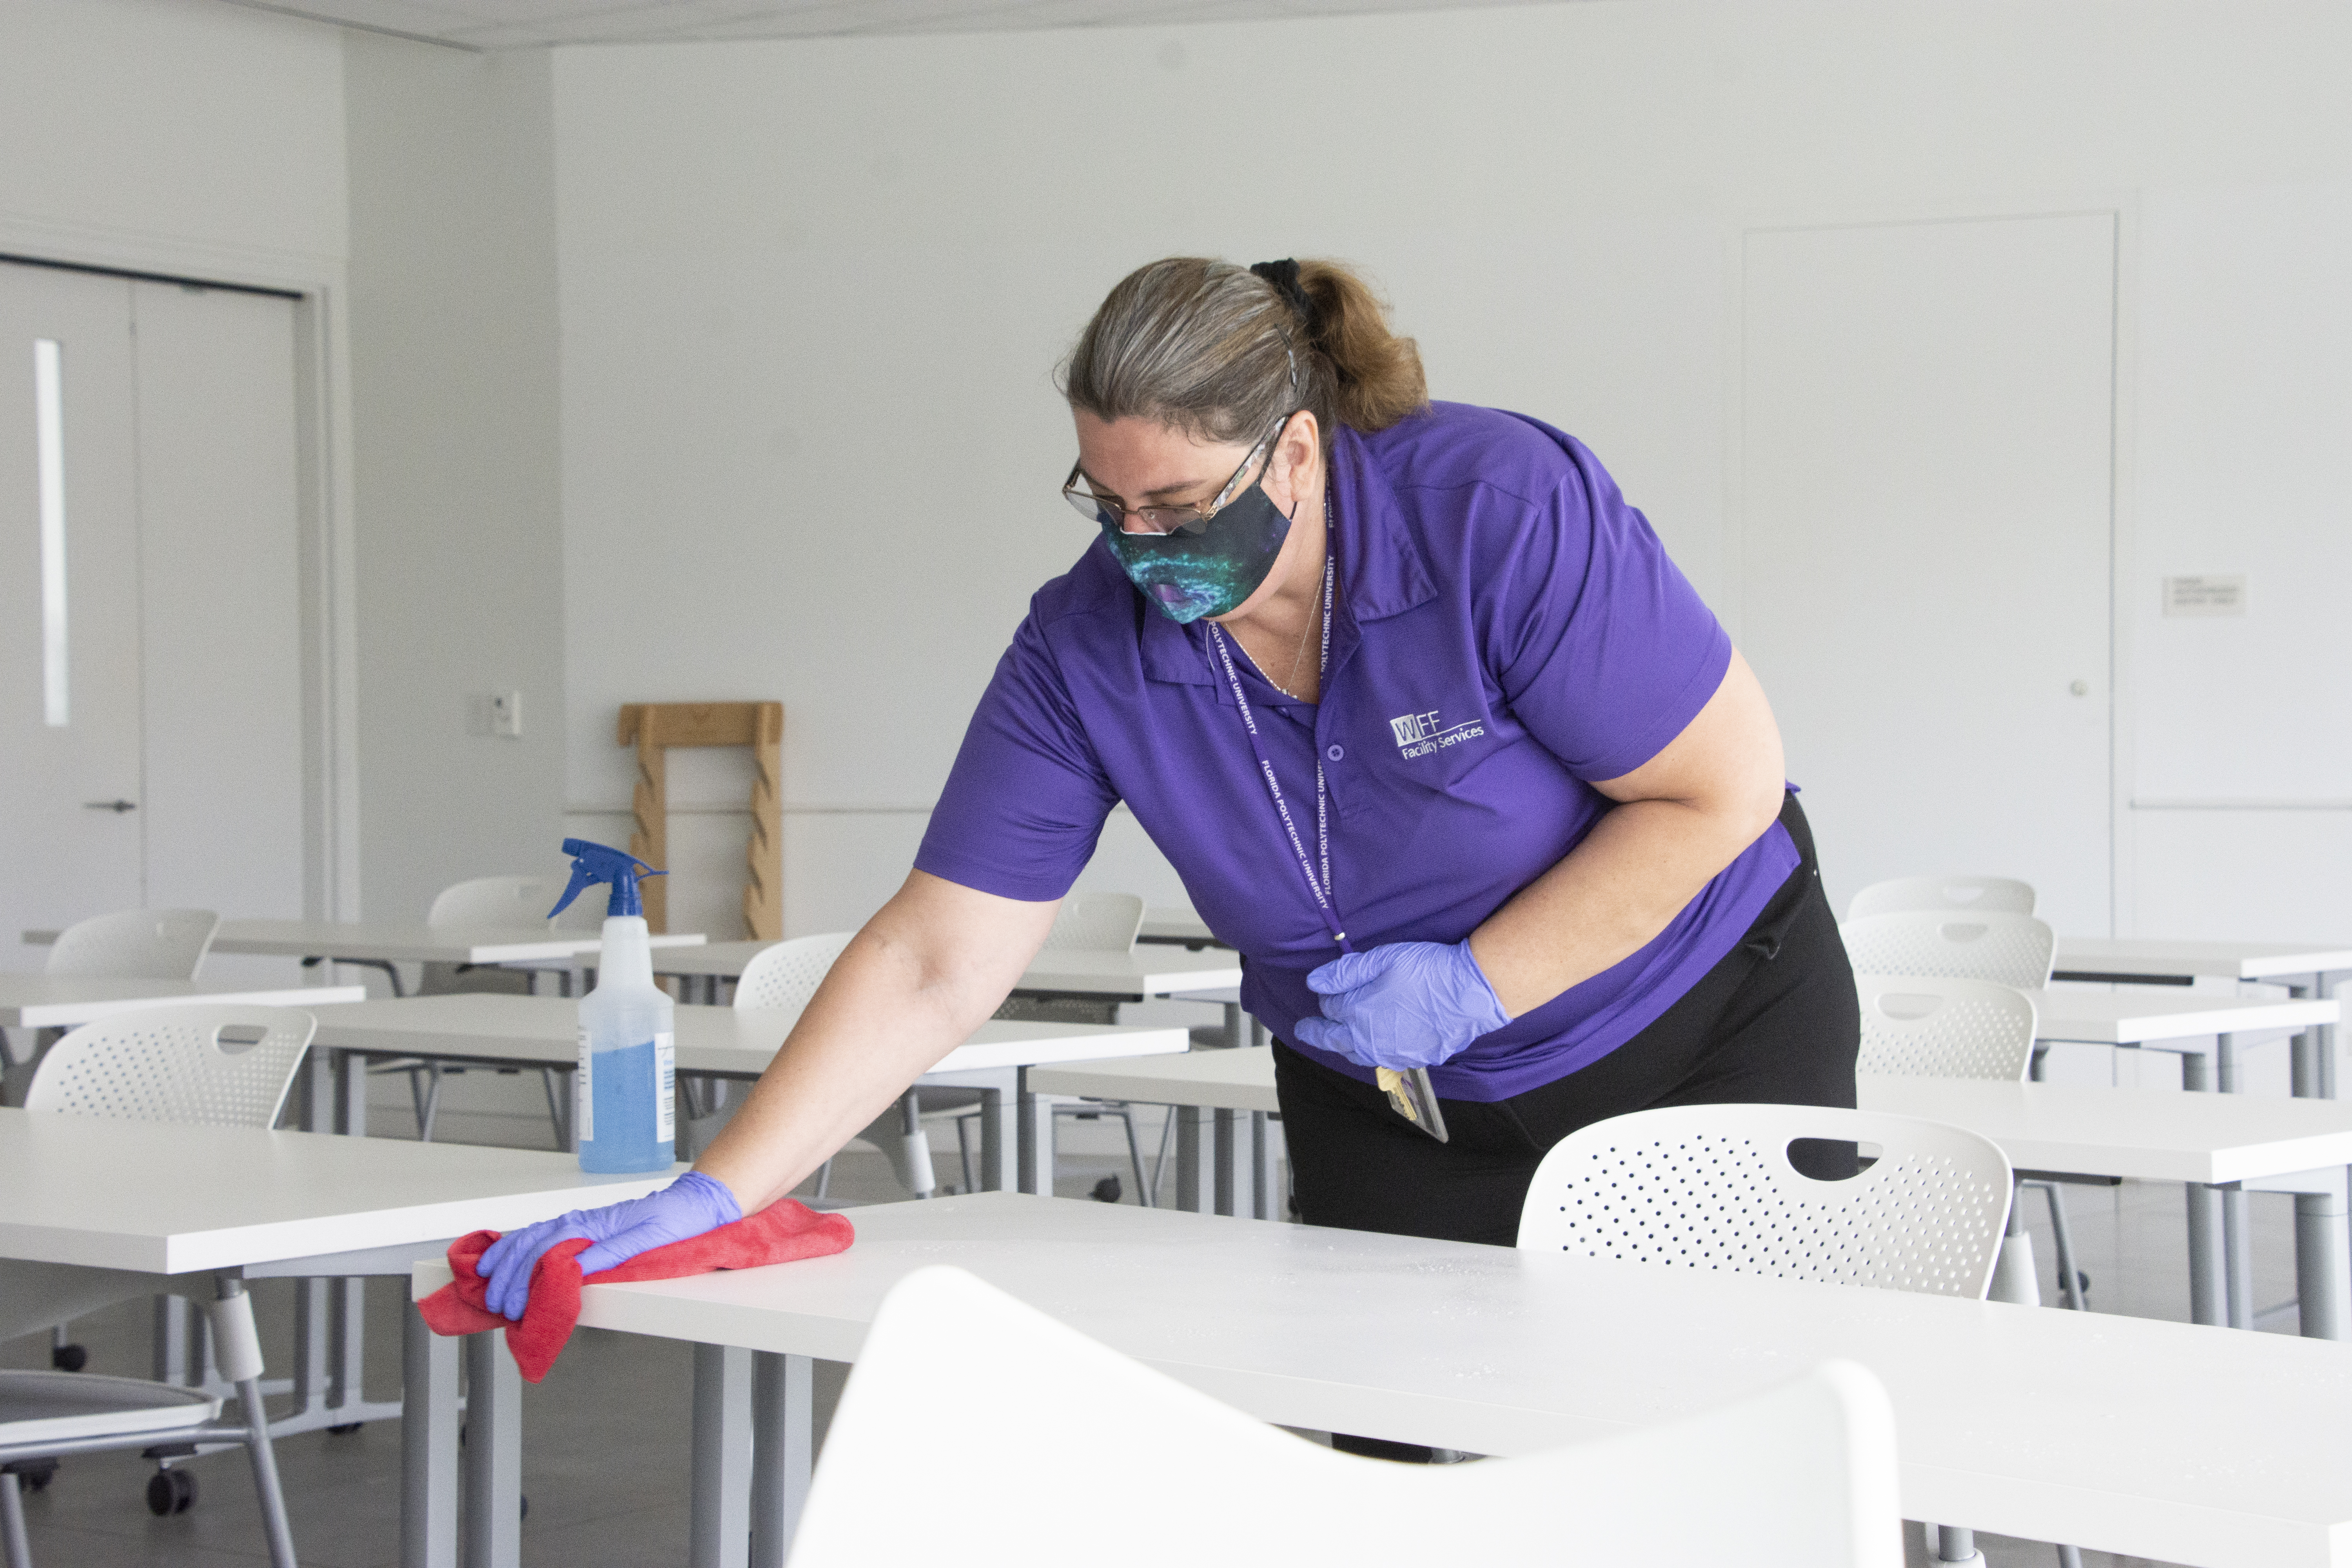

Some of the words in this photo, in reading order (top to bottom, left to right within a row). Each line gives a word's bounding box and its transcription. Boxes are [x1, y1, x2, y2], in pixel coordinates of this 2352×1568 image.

[1325, 555, 1335, 609] UNIVERSITY
[1209, 621, 1237, 681] POLYTECHNIC
[1233, 682, 1257, 735] UNIVERSITY
[1394, 710, 1440, 743] WFF
[1402, 740, 1437, 760] Facility
[1438, 726, 1484, 748] Services
[1262, 760, 1281, 799] FLORIDA
[1277, 799, 1306, 859] POLYTECHNIC
[1303, 860, 1328, 909] UNIVERSITY
[1318, 794, 1328, 855] POLYTECHNIC
[1322, 857, 1331, 895] FLORIDA
